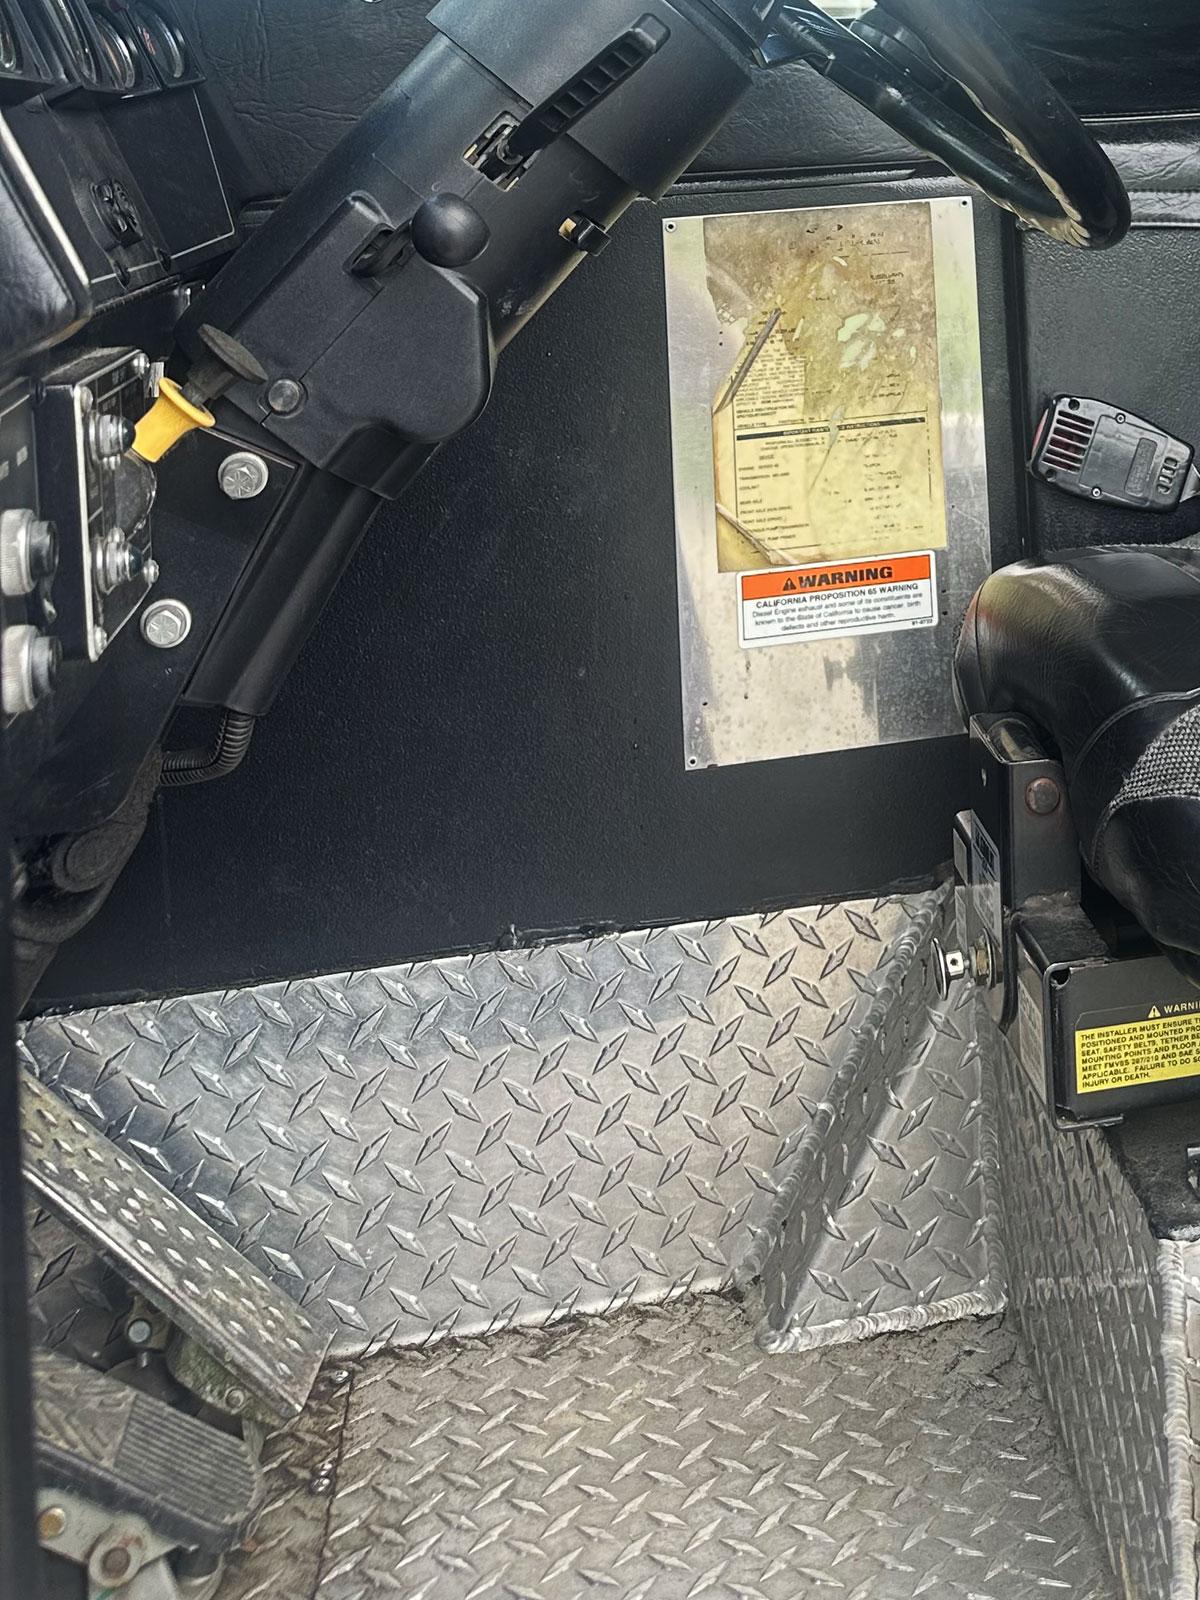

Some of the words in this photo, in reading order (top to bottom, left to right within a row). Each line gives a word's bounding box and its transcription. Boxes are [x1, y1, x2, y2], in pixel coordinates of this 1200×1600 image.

[798, 566, 893, 589] WARNING
[756, 596, 807, 608] CALIFORNIA
[810, 589, 866, 603] PROPOSITION
[868, 587, 877, 595] 65
[880, 583, 919, 594] WARNING
[755, 618, 776, 627] known
[786, 614, 796, 623] the
[798, 612, 814, 621] State
[815, 611, 823, 619] of
[823, 607, 853, 618] California
[855, 606, 862, 614] to
[863, 606, 881, 614] cause
[907, 600, 921, 609] birth
[775, 606, 796, 617] Engine
[798, 603, 823, 613] exhaust
[838, 600, 853, 608] some
[782, 623, 805, 632] defects
[807, 620, 819, 629] and
[820, 618, 835, 628] other
[837, 613, 876, 627] reproductive
[1081, 1033, 1095, 1041] THE
[1098, 1027, 1137, 1038] INSTALLER
[1139, 1024, 1160, 1032] MUST
[1163, 1018, 1192, 1029] ENSURE
[1081, 1037, 1126, 1049] POSITIONED
[1129, 1034, 1144, 1042] AND
[1147, 1027, 1183, 1039] MOUNTED
[1082, 1054, 1122, 1065] MOUNTING
[1124, 1048, 1151, 1058] POINTS
[1172, 1041, 1196, 1050] FLOOR
[1104, 1043, 1132, 1053] SAFETY
[1161, 1033, 1189, 1044] TETHER
[1082, 1064, 1102, 1072] MEET
[1135, 1062, 1166, 1072] FAILURE
[1082, 1078, 1109, 1088] INJURY
[1125, 1072, 1151, 1082] DEATH.
